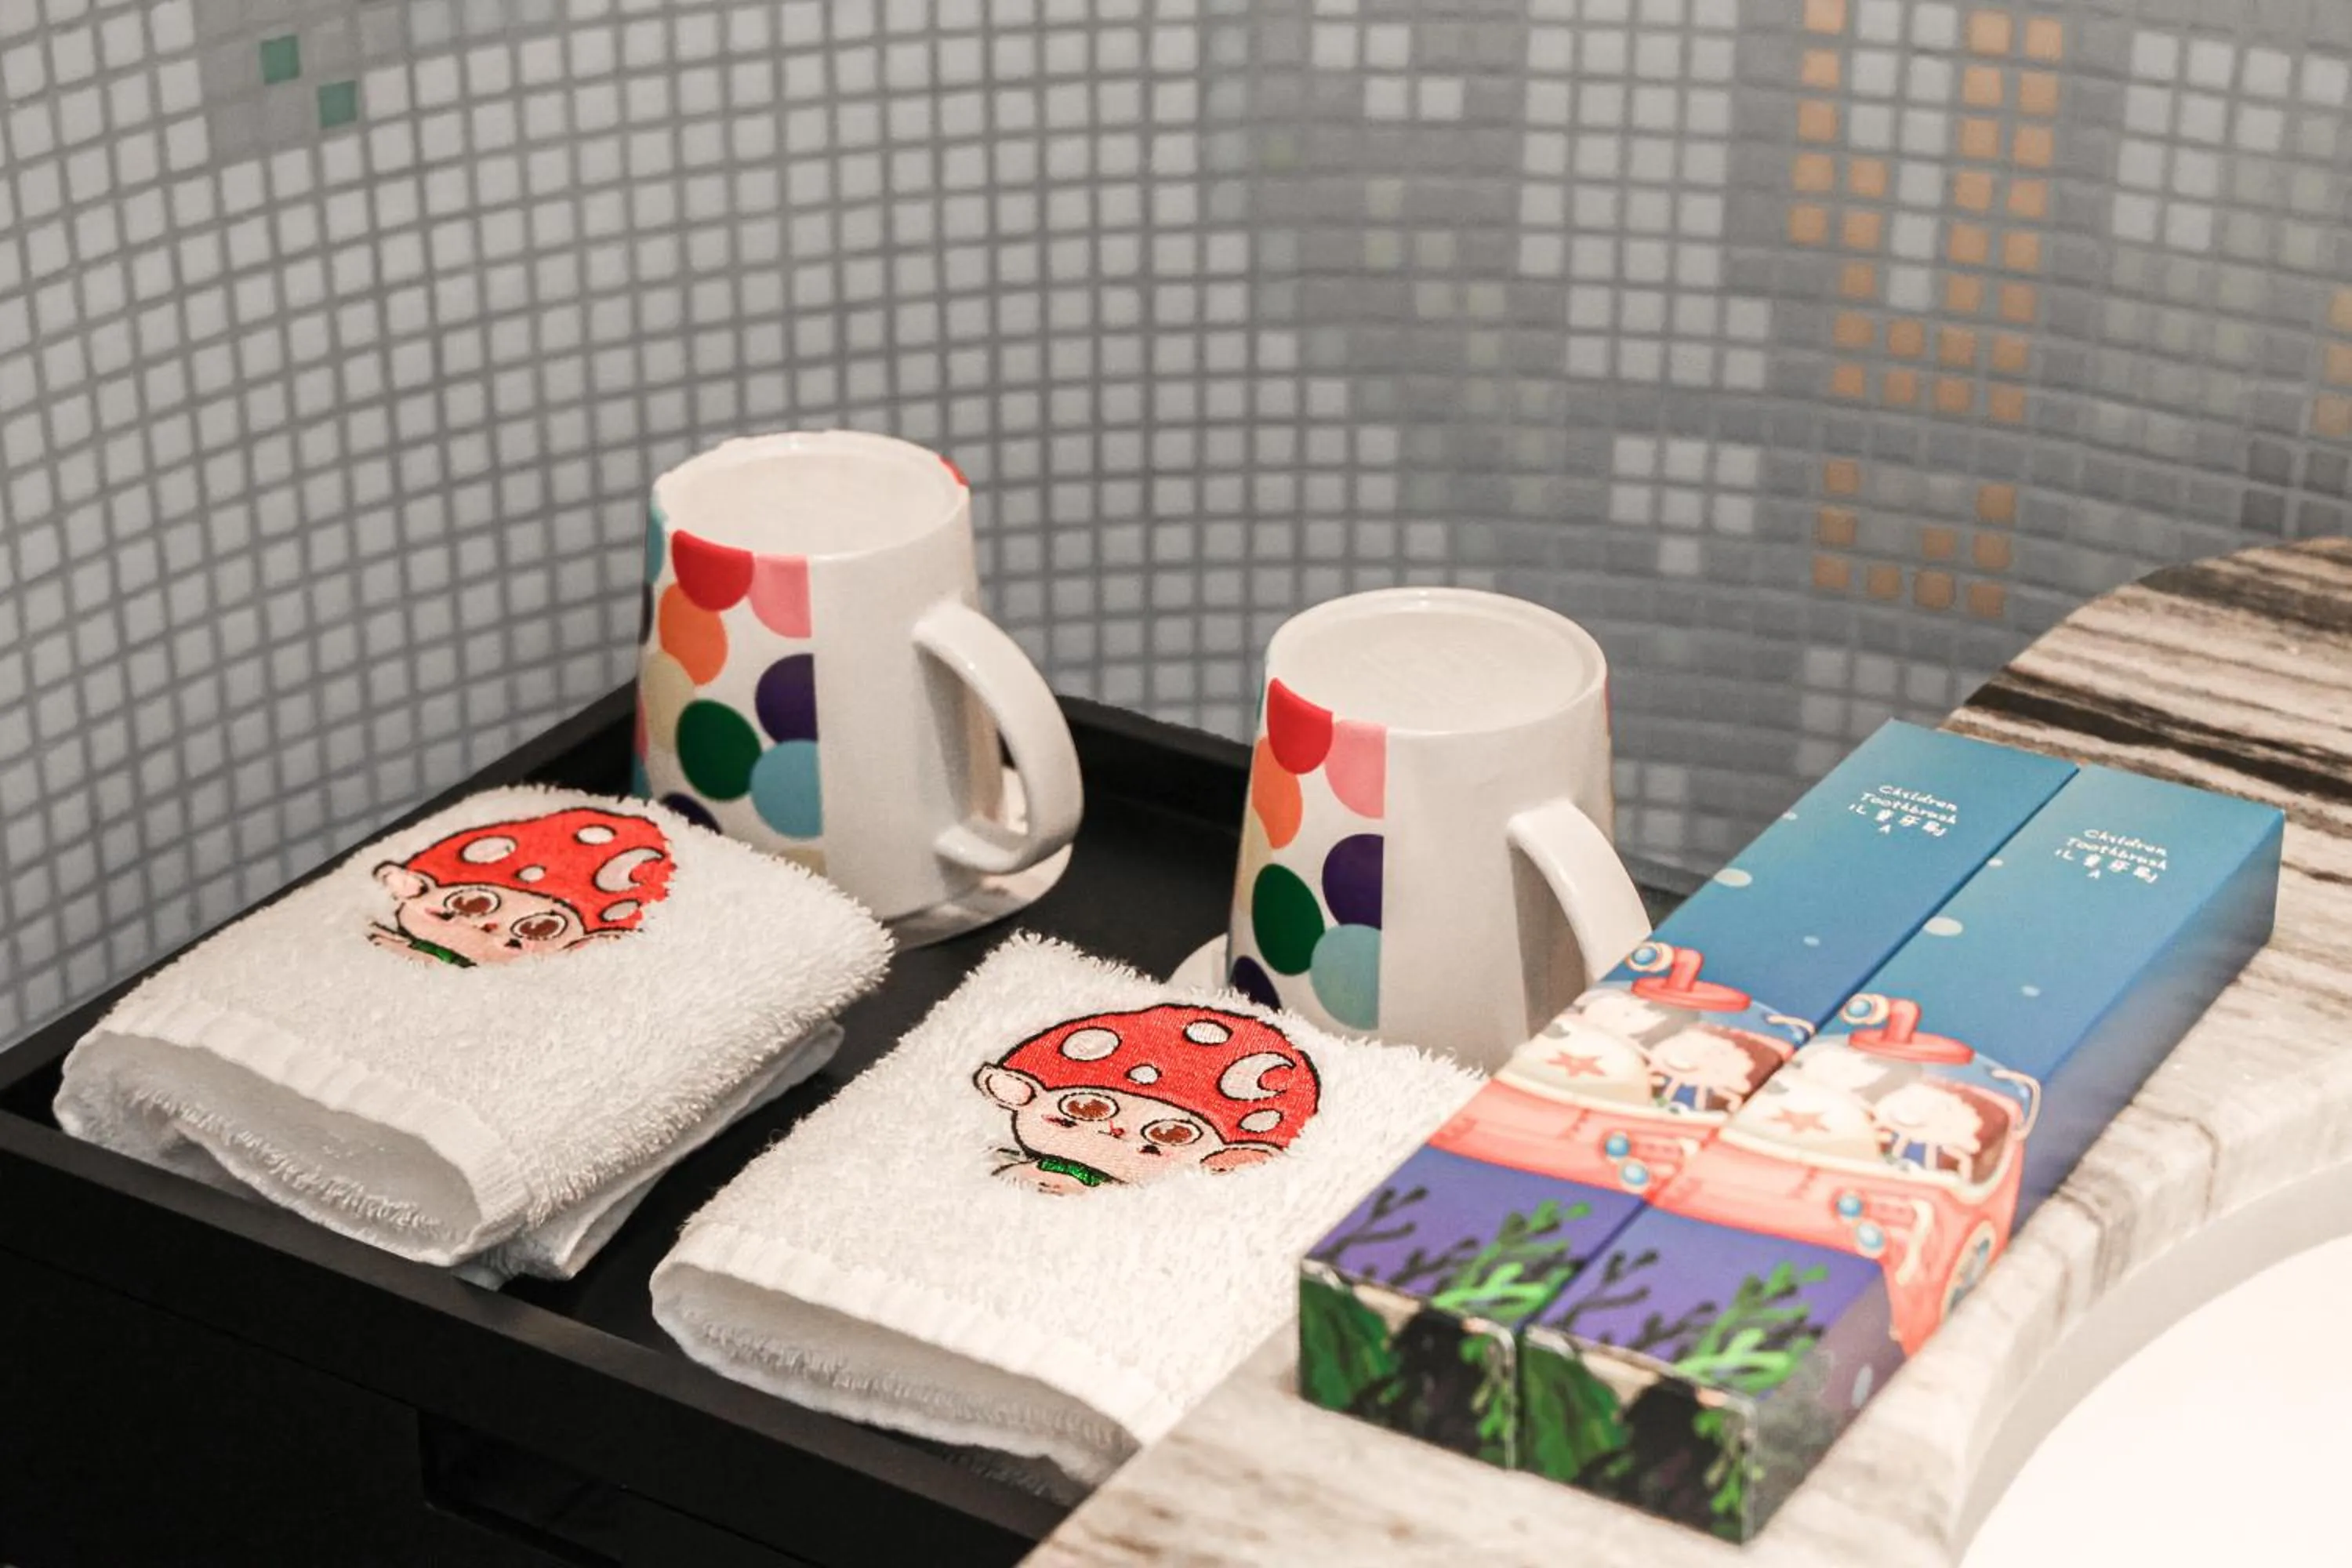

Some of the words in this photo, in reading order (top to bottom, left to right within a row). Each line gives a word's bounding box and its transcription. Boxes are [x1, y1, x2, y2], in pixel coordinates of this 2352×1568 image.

[1860, 791, 1957, 825] Toothbrush
[1878, 785, 1958, 812] Children
[2067, 837, 2167, 872] Toothbrush
[2084, 829, 2168, 857] Children
